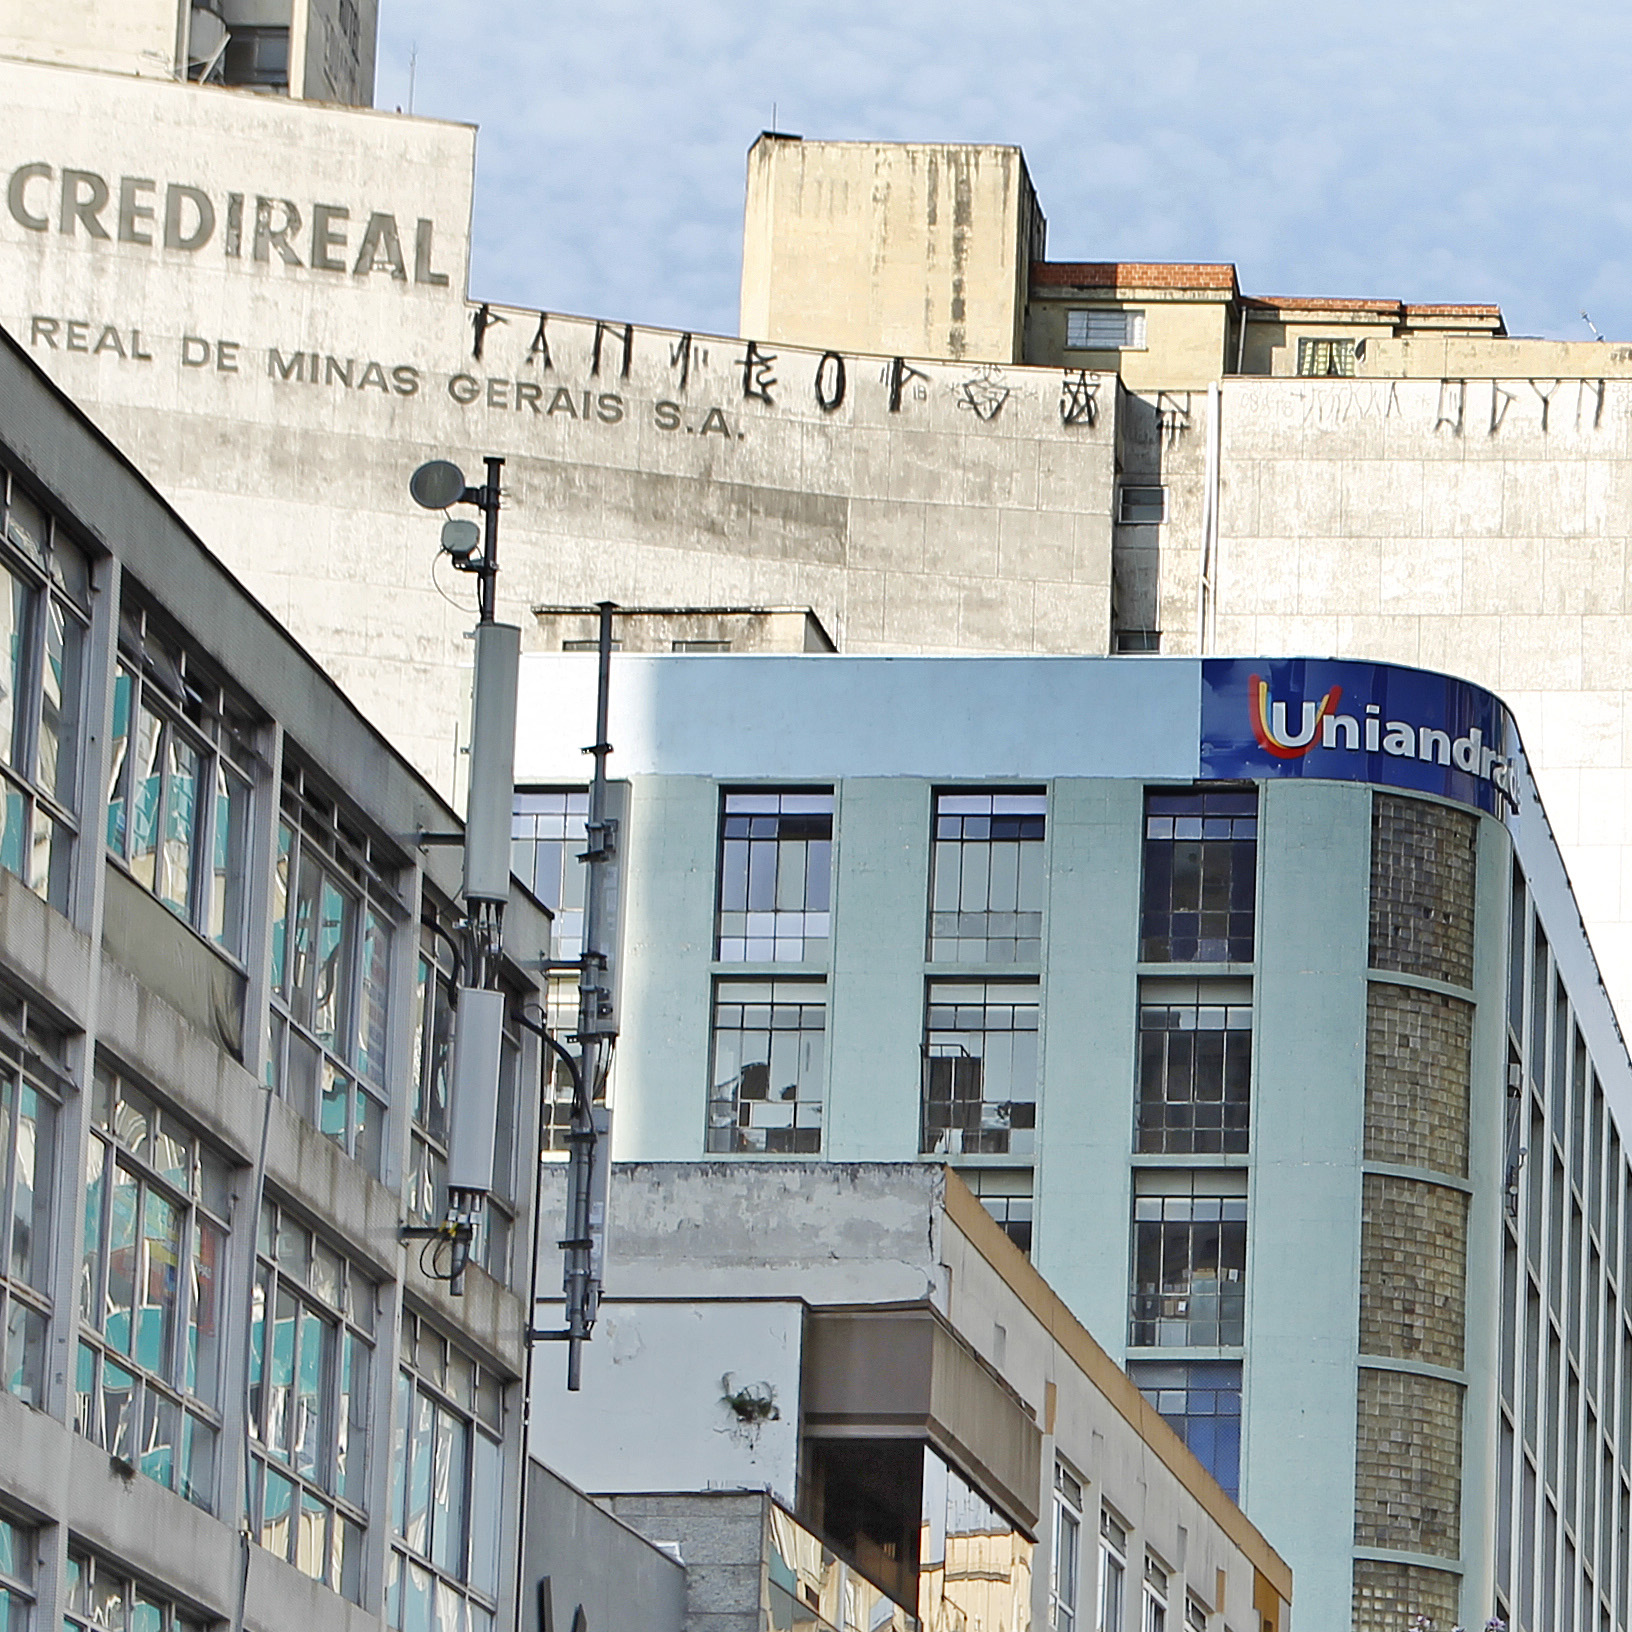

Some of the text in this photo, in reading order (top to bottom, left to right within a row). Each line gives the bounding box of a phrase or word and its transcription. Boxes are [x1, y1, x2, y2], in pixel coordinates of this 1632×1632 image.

[8, 163, 451, 287] CREDIREAL
[30, 316, 154, 363] REAL
[181, 335, 240, 373] DE
[266, 348, 420, 397] MINAS
[447, 372, 625, 423] GERAIS
[654, 403, 746, 440] S.A.
